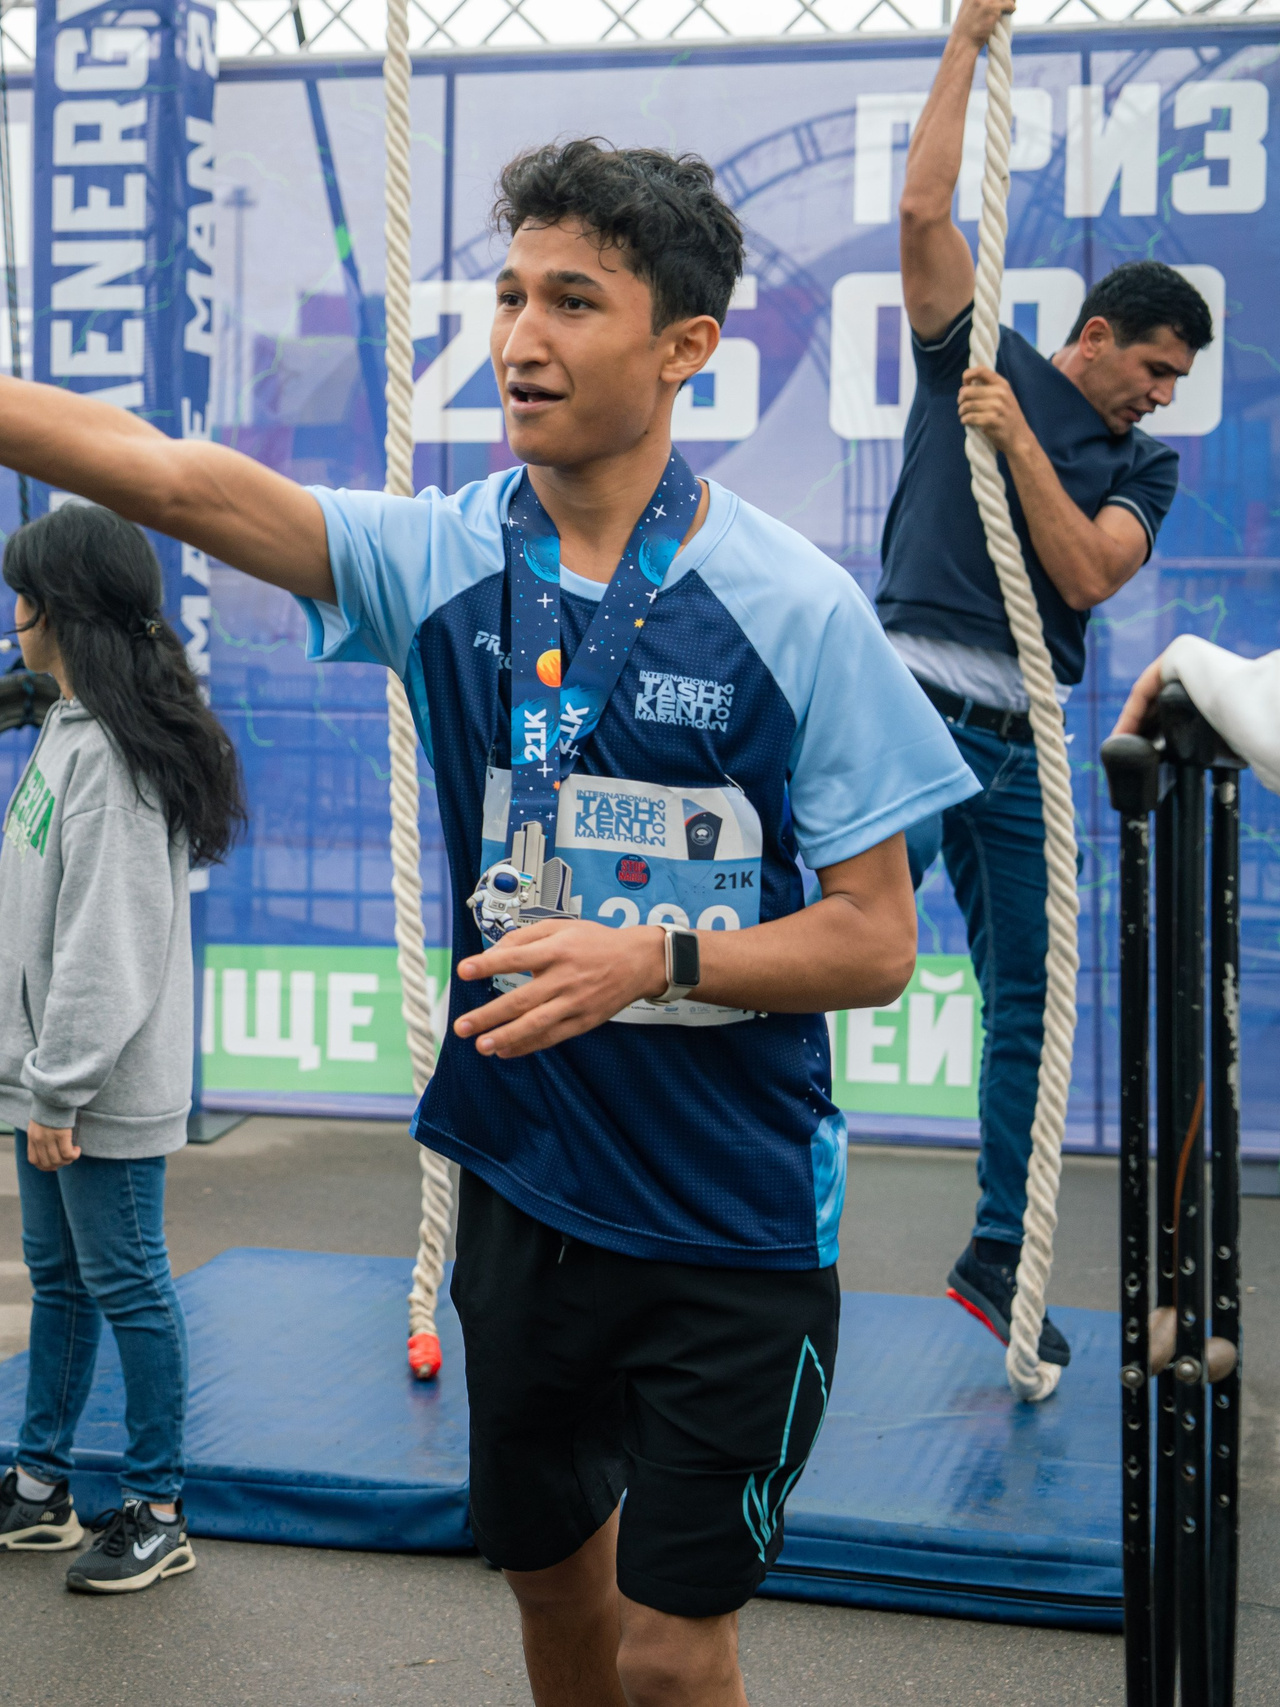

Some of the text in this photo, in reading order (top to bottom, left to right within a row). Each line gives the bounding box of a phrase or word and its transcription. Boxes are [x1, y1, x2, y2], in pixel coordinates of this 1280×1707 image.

[639, 670, 719, 688] INTERNATIONAL
[639, 677, 721, 710] TASH
[635, 693, 713, 721] KENT
[635, 709, 716, 731] MARATHON
[524, 708, 547, 762] 21K
[576, 789, 652, 804] INTERNATIONAL
[577, 795, 655, 824] TASH
[575, 812, 648, 837] KENT
[575, 829, 655, 845] MARATHON
[620, 859, 647, 873] STOP
[714, 870, 754, 890] 21K
